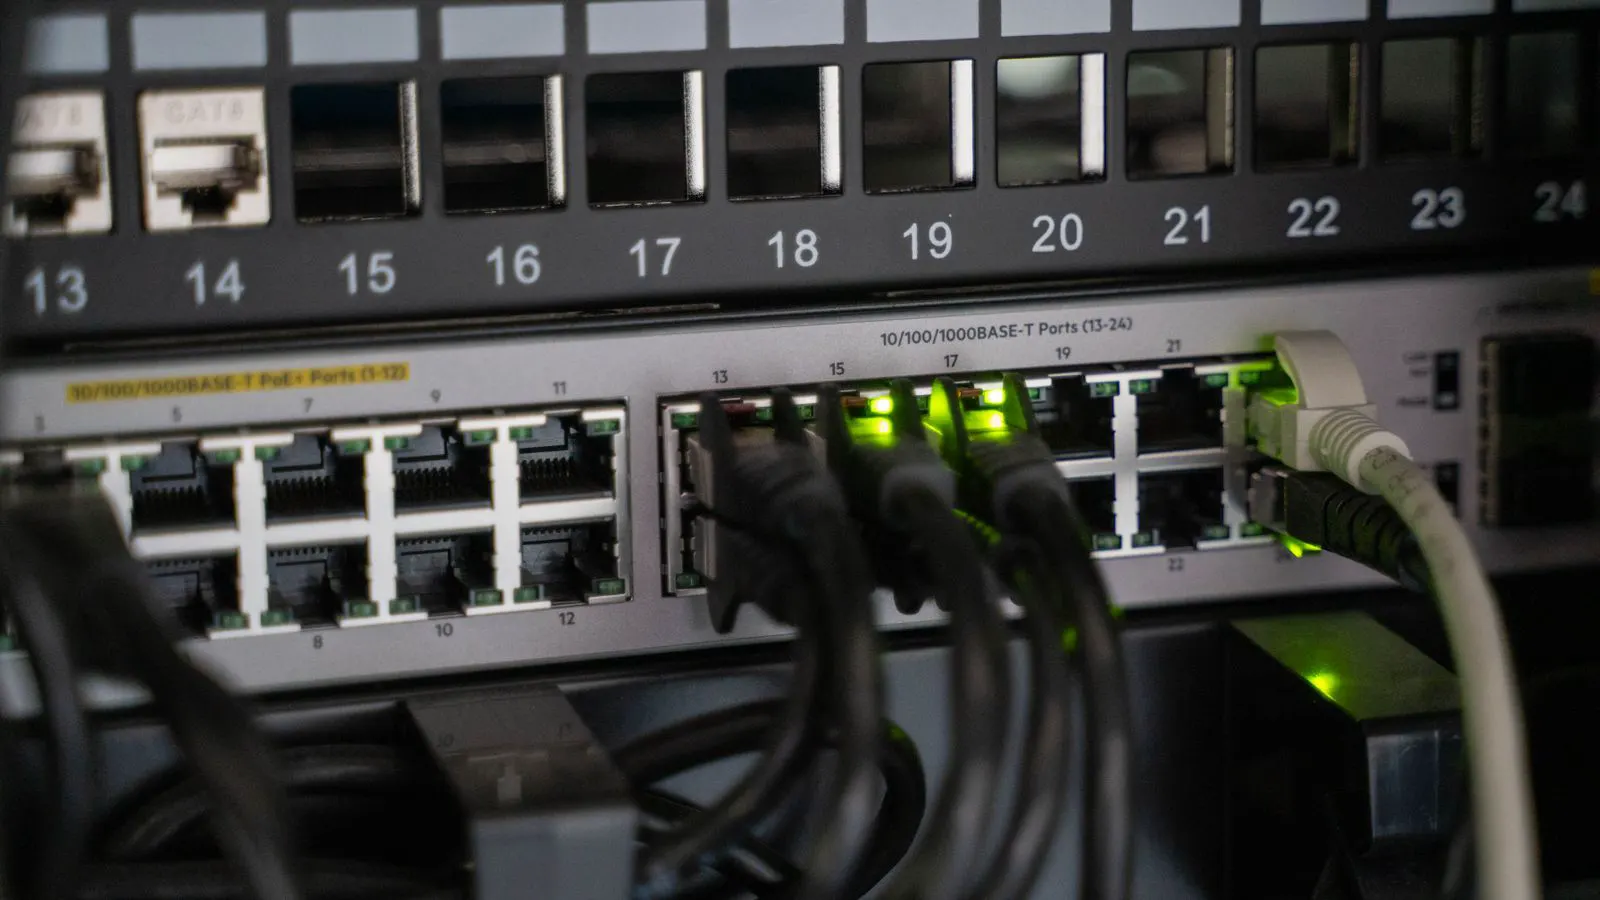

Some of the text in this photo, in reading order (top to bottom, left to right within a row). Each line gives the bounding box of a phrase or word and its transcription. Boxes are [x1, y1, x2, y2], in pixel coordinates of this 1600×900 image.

[1410, 188, 1465, 229] 23
[1534, 181, 1586, 220] 24
[1032, 213, 1083, 252] 20
[1164, 206, 1210, 245] 21
[1286, 198, 1340, 237] 22
[629, 238, 682, 276] 17
[768, 229, 818, 268] 18
[903, 221, 953, 260] 19
[339, 253, 396, 294] 15
[487, 244, 541, 285] 16
[27, 268, 88, 313] 13
[187, 260, 245, 303] 14
[880, 316, 1133, 346] 10/100/1000BASE-T Ports (13-24)
[1166, 339, 1182, 353] 21
[830, 362, 846, 376] 15
[943, 354, 959, 368] 17
[1056, 346, 1072, 361] 19
[72, 365, 406, 402] 10/100/1000BASE-T PoE+ Ports (1-12)
[552, 382, 567, 395] 11
[713, 370, 729, 384] 13
[302, 398, 314, 413] 7
[430, 389, 442, 403] 9
[1168, 557, 1184, 571] 22
[435, 623, 453, 637] 10
[558, 612, 576, 626] 12
[312, 635, 324, 649] 8
